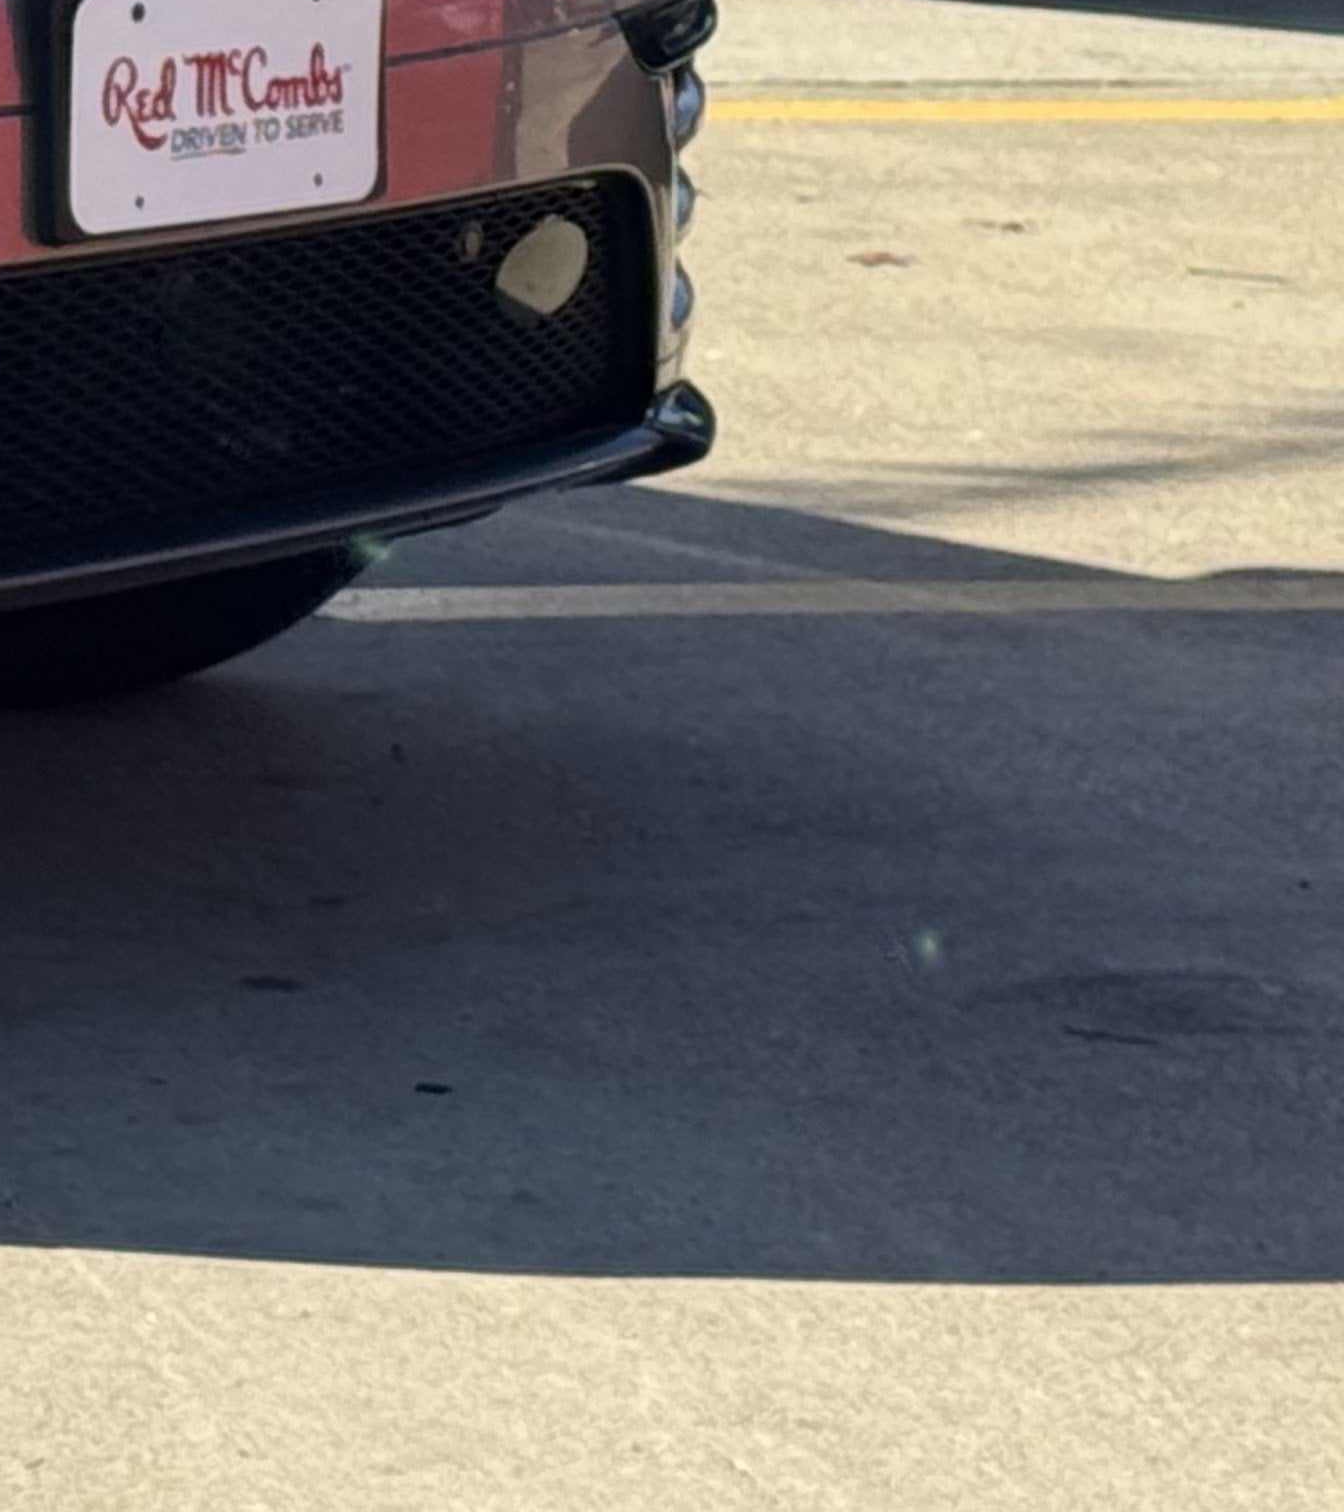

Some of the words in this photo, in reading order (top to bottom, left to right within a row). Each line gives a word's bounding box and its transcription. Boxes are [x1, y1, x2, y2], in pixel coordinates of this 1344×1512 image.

[102, 55, 177, 152] Red
[182, 42, 344, 118] McCombs
[169, 121, 248, 155] DRIVEN
[253, 116, 281, 145] TO
[285, 108, 345, 141] SERVE
